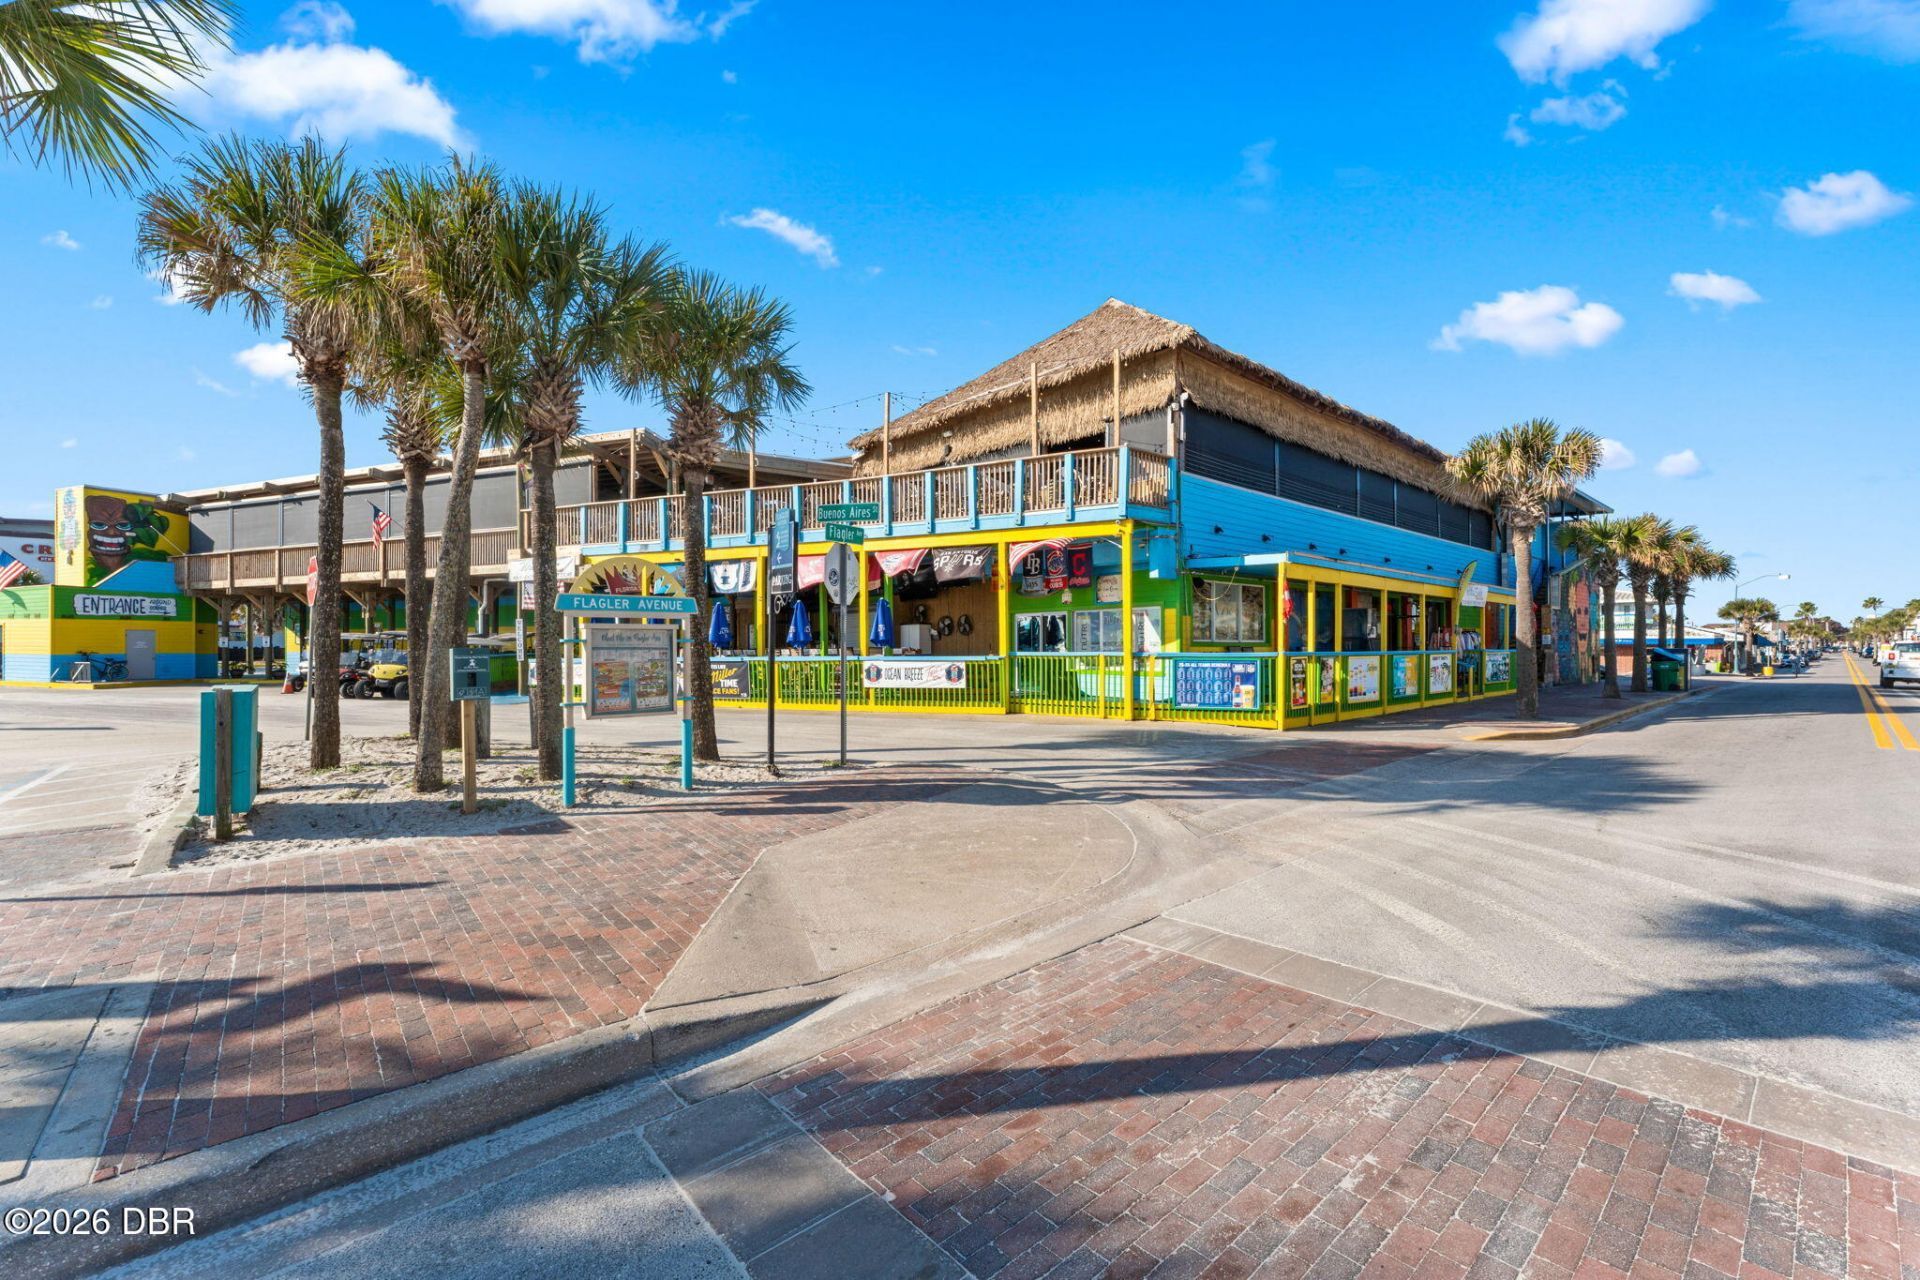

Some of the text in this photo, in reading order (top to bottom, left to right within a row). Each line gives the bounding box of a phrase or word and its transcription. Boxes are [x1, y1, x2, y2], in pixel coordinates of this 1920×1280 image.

[818, 507, 846, 519] Buenos
[849, 506, 871, 518] Aires
[829, 525, 855, 542] Flagler
[772, 574, 792, 586] PARKING
[82, 596, 146, 615] ENTRANCE
[573, 597, 683, 611] FLAGLER AVENUE
[711, 668, 738, 684] Miller
[884, 667, 901, 680] OCEAN
[904, 667, 923, 681] BREEZE
[720, 679, 738, 688] TIME
